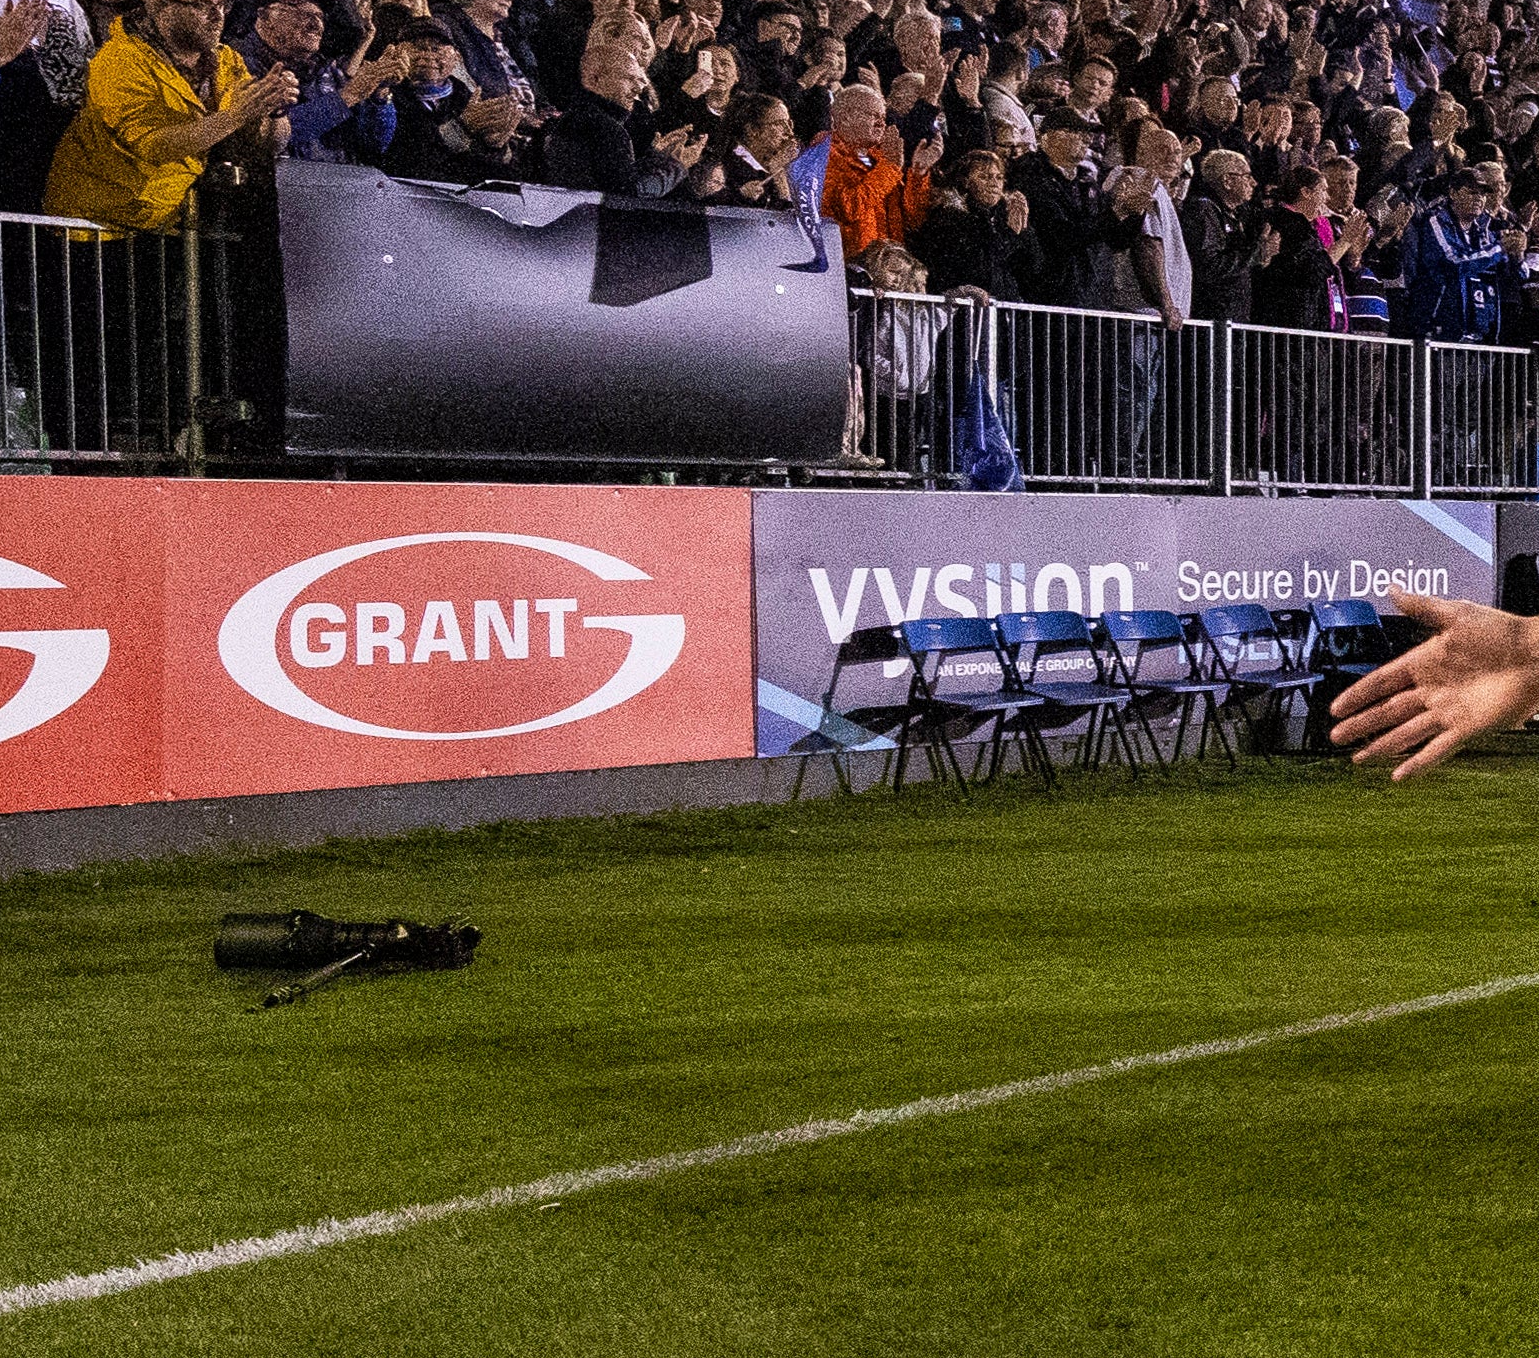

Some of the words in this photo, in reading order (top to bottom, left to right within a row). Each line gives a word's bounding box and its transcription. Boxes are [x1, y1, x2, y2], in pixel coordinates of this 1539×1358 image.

[1177, 560, 1293, 602] Secure
[1304, 560, 1340, 601] by
[1350, 559, 1449, 596] Design
[289, 597, 578, 668] GRANT
[938, 665, 953, 677] AN
[1045, 657, 1084, 672] GROUP
